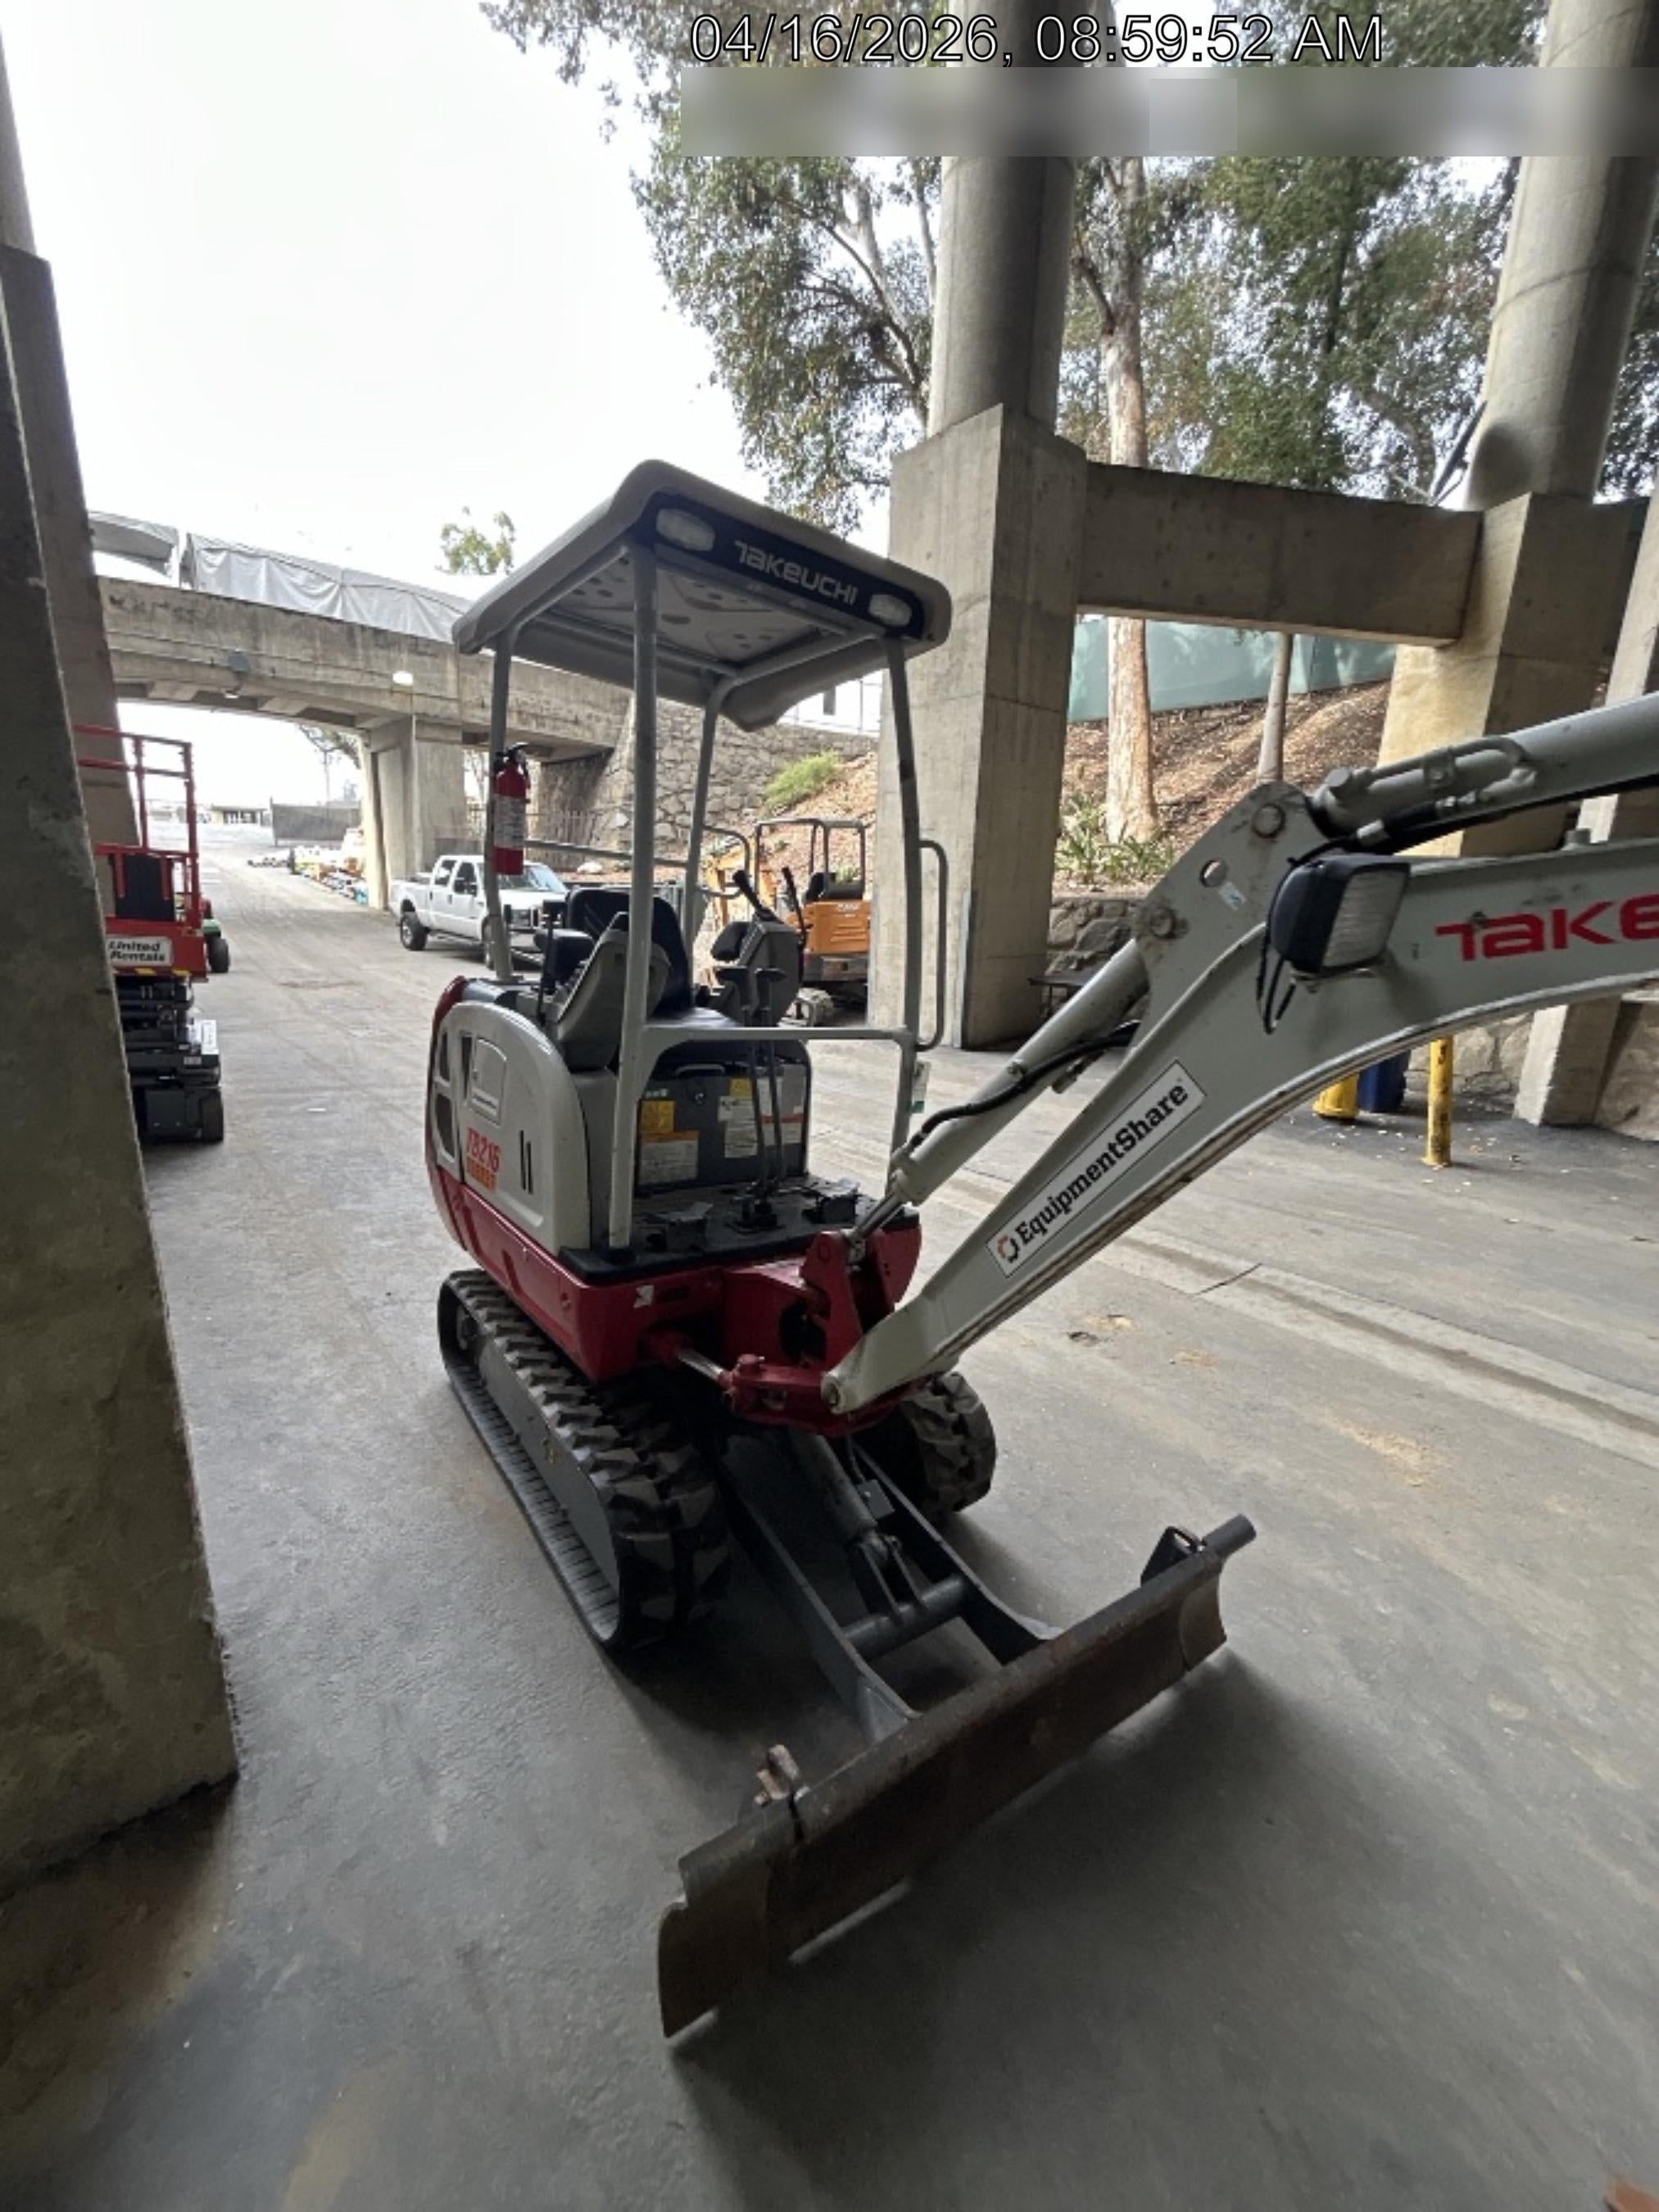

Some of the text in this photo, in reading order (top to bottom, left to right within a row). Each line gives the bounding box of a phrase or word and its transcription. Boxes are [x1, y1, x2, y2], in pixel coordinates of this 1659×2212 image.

[109, 941, 161, 951] United
[110, 950, 165, 962] Rentals
[1015, 1085, 1189, 1245] EquipmentShare
